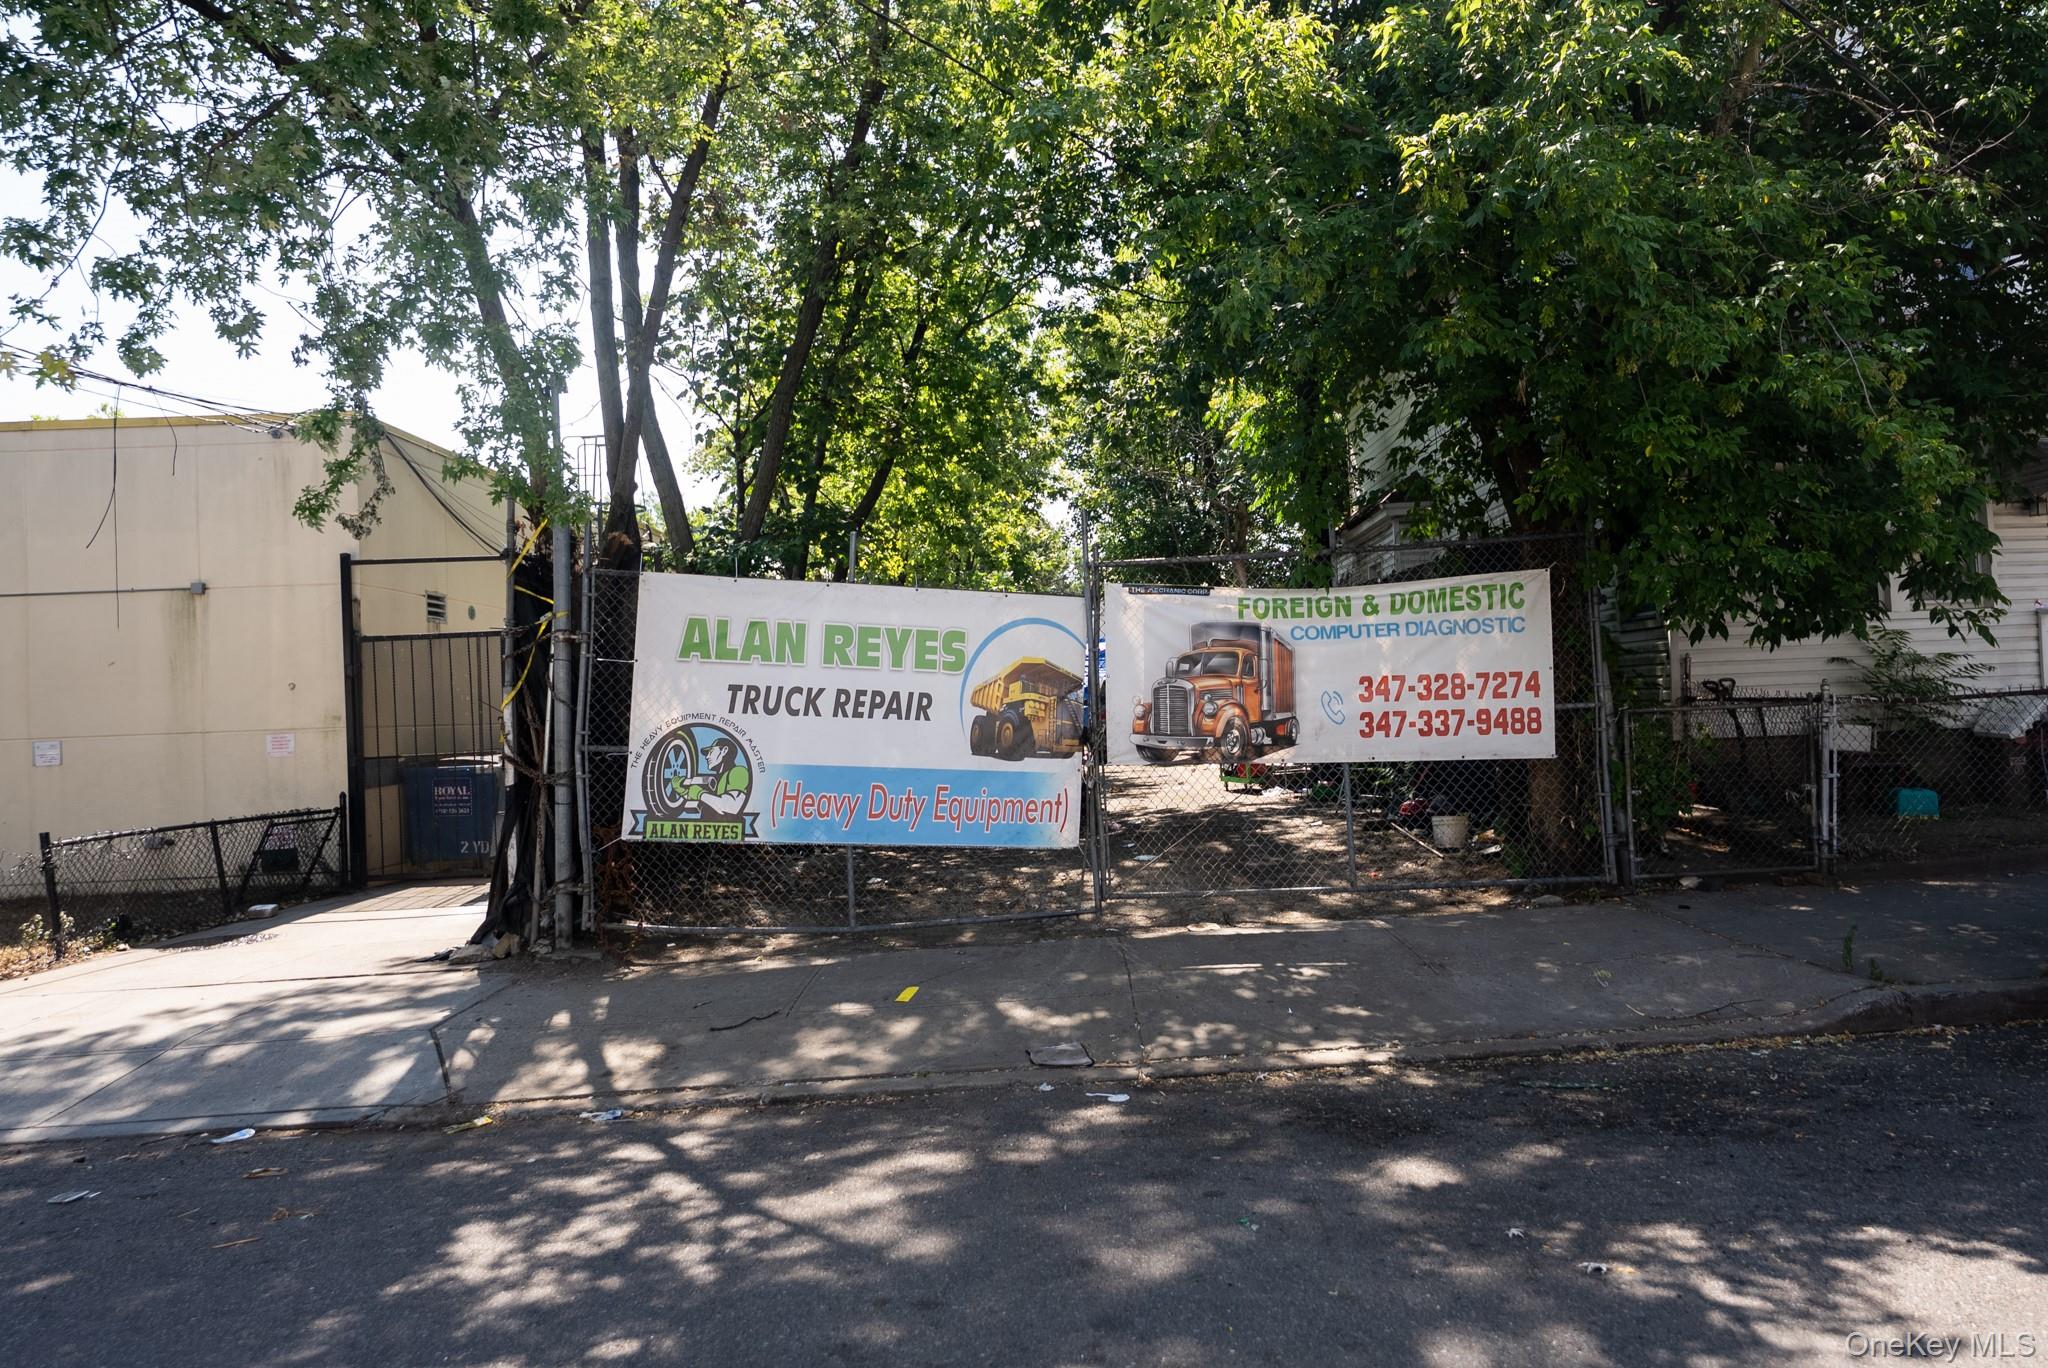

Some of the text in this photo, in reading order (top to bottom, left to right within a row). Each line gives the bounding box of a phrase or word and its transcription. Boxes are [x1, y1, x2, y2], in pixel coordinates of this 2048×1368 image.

[1237, 582, 1526, 621] FOREIGN & DOMESTIC
[677, 616, 967, 673] ALAN REYES
[1290, 616, 1526, 641] COMPUTER DIAGNOSTIC
[728, 684, 933, 722] TRUCK REPAIR
[1358, 671, 1541, 703] 347-328-7274
[1358, 707, 1542, 739] 347-337-9488
[631, 712, 766, 774] THE HEAVY EQUIPMENT REPAIR MASTER
[771, 777, 1068, 833] (Heavy Duty Equipment)
[460, 841, 469, 854] 2
[650, 823, 739, 839] ALAN REYES
